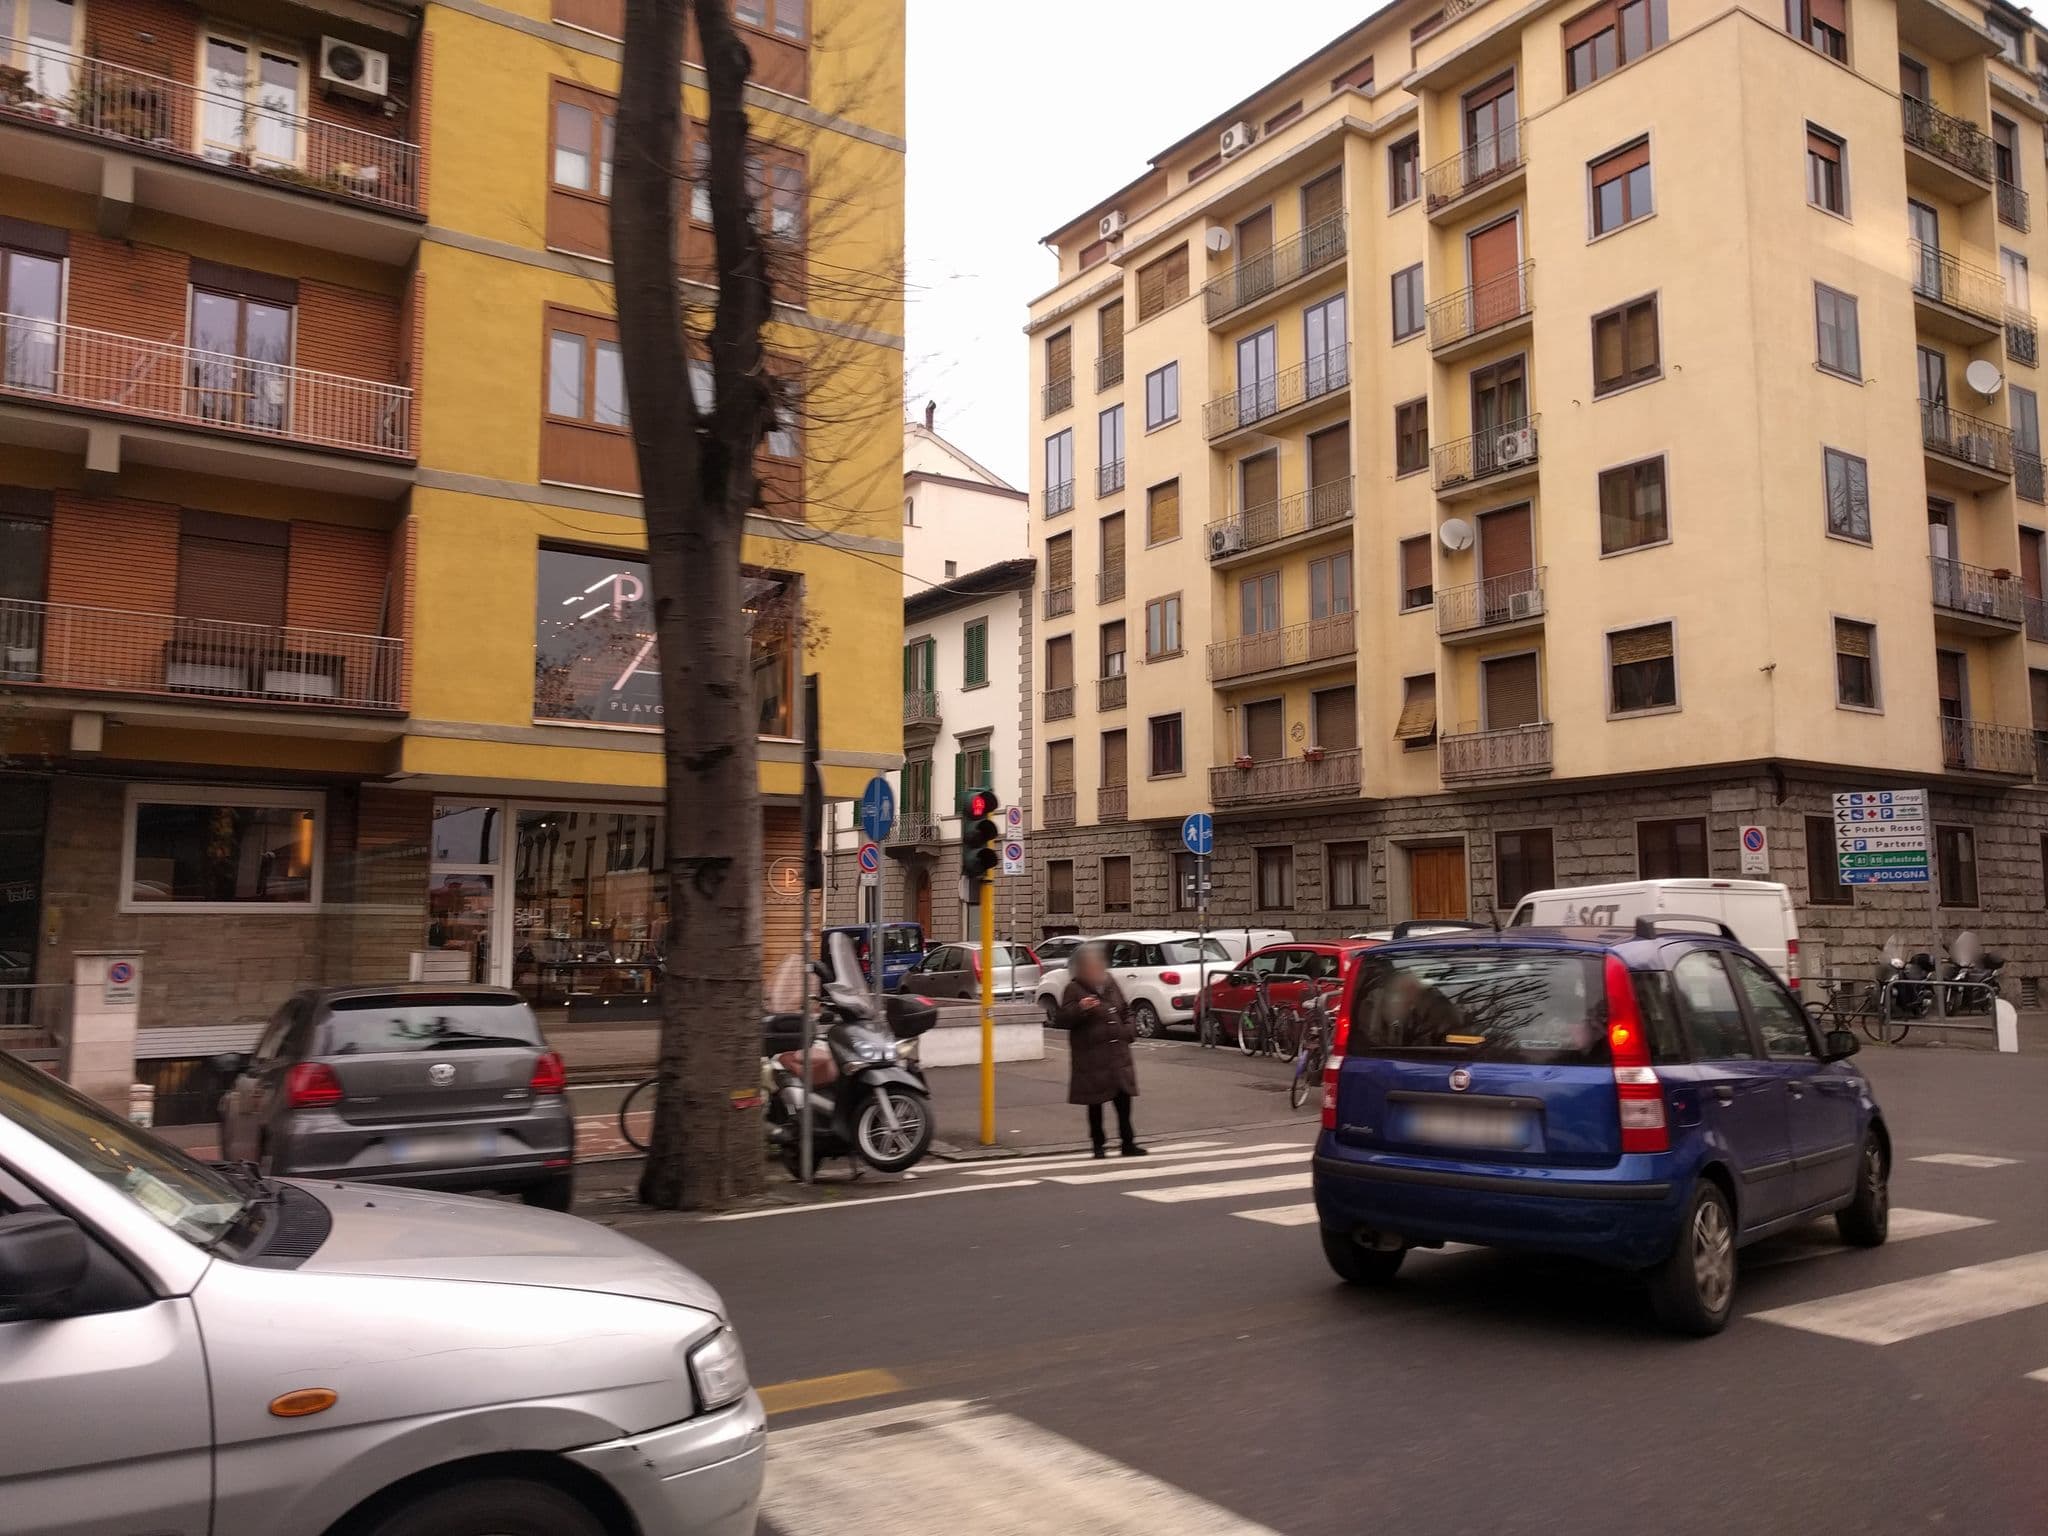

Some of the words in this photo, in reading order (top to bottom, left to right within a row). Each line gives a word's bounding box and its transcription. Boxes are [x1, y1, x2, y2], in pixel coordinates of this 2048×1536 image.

[1890, 824, 1922, 832] Rosso
[1884, 855, 1925, 864] autostrade
[1873, 870, 1926, 879] BOLOGNA
[1580, 905, 1620, 926] SGT
